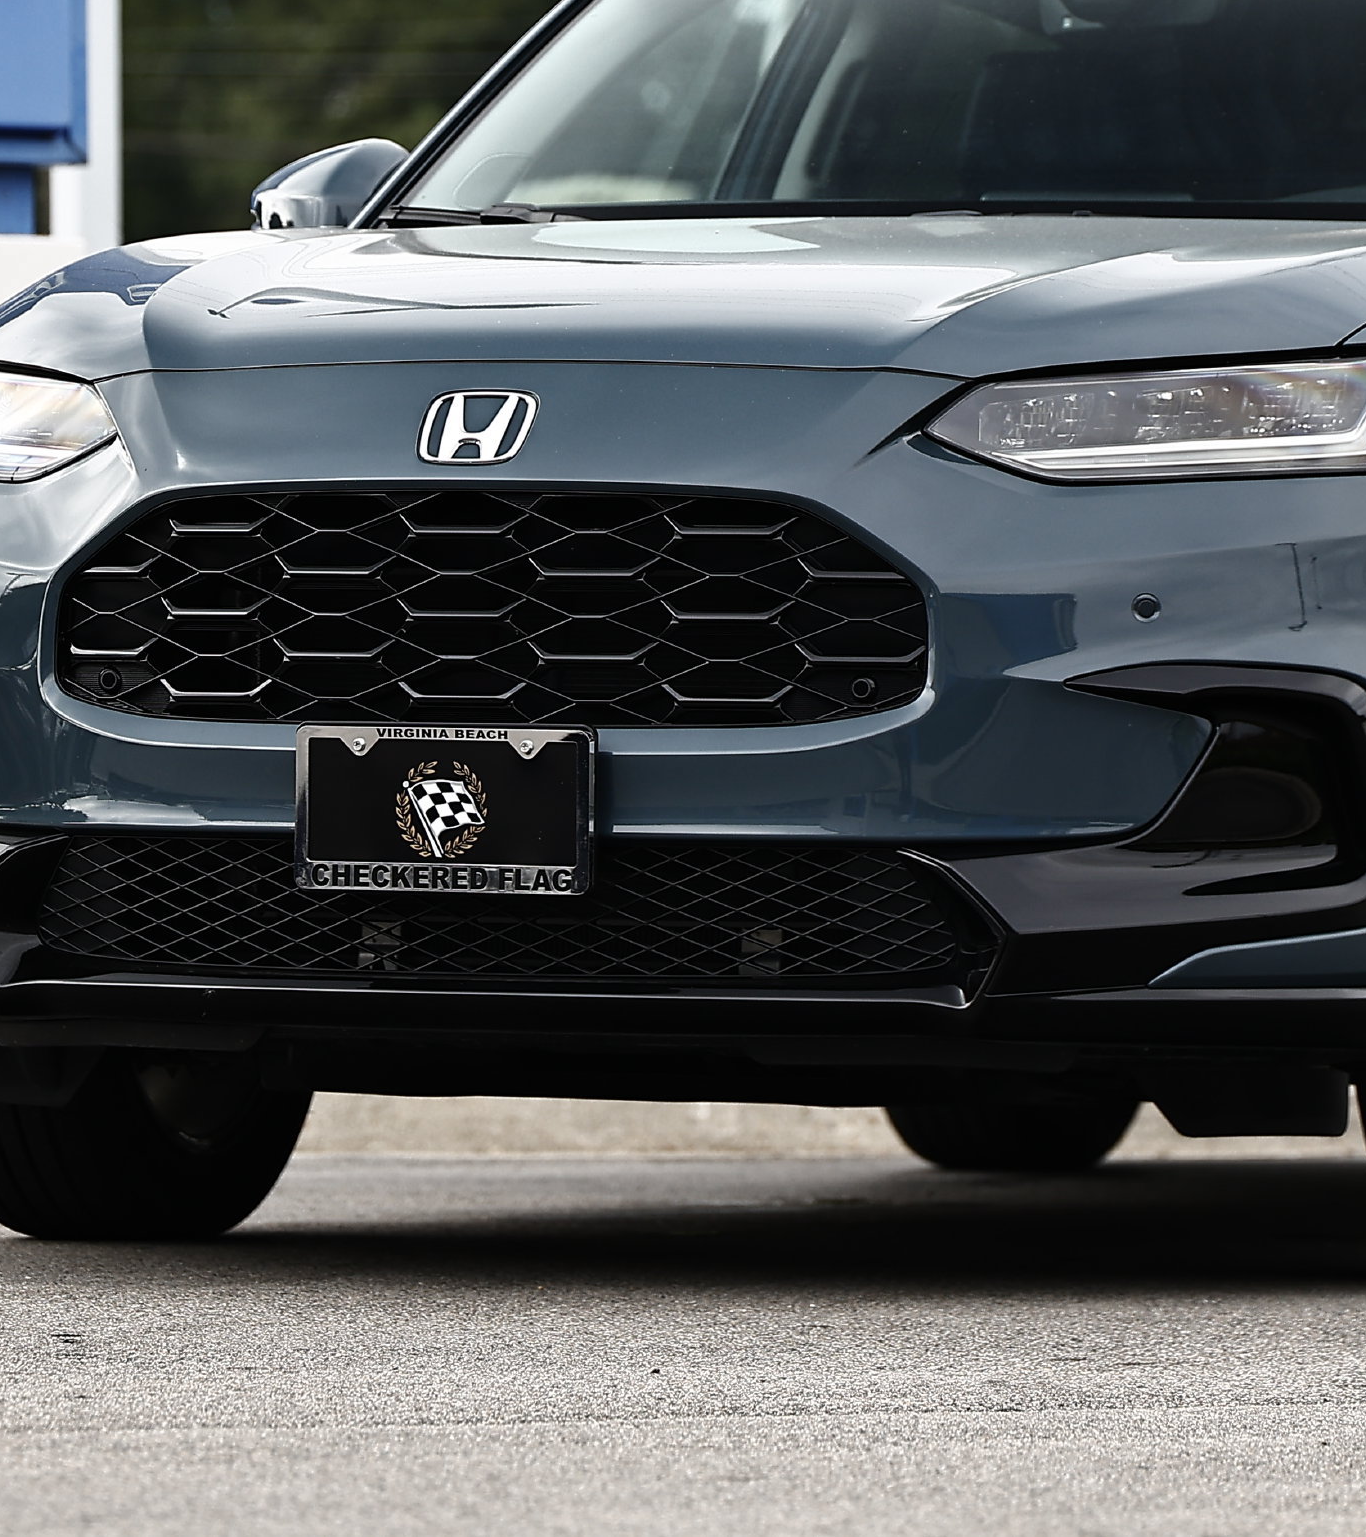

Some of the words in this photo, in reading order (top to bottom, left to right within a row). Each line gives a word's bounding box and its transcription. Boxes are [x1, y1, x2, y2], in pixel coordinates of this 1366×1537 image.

[376, 727, 450, 739] VIRGINIA
[454, 728, 509, 740] BEACH
[311, 863, 488, 890] CHECKERED
[498, 867, 573, 893] FLAG
